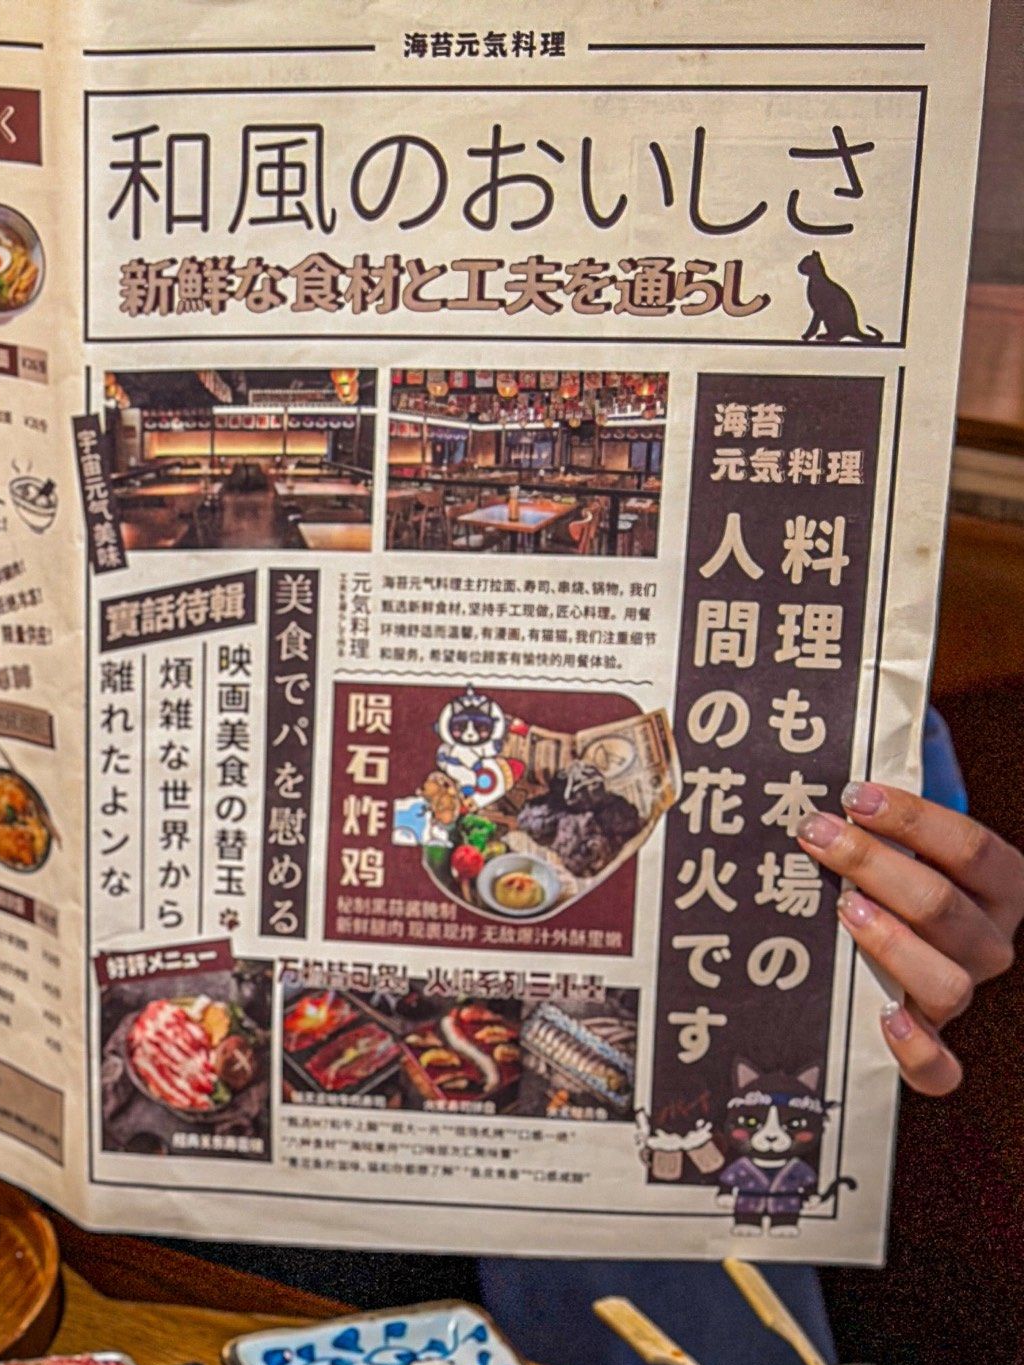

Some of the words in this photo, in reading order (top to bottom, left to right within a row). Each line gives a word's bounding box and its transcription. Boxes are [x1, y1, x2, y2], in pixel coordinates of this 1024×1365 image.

[403, 30, 566, 58] 海苔元気料理
[108, 123, 875, 239] 和風のおいしさ
[118, 250, 772, 319] 新鮮な食材と工夫を通らし
[710, 446, 864, 485] 元気料理
[713, 403, 786, 439] 海苔
[350, 572, 372, 660] 元気料理
[99, 659, 135, 898] 離れたよンな
[157, 656, 194, 930] 煩雑な世界から
[213, 643, 253, 897] 映画美食の替玉
[267, 573, 314, 935] 美食でパを慰める
[339, 692, 393, 889] 陨石炸鸡
[667, 511, 764, 1065] 人間の花火です
[746, 515, 850, 991] 料理も本場の
